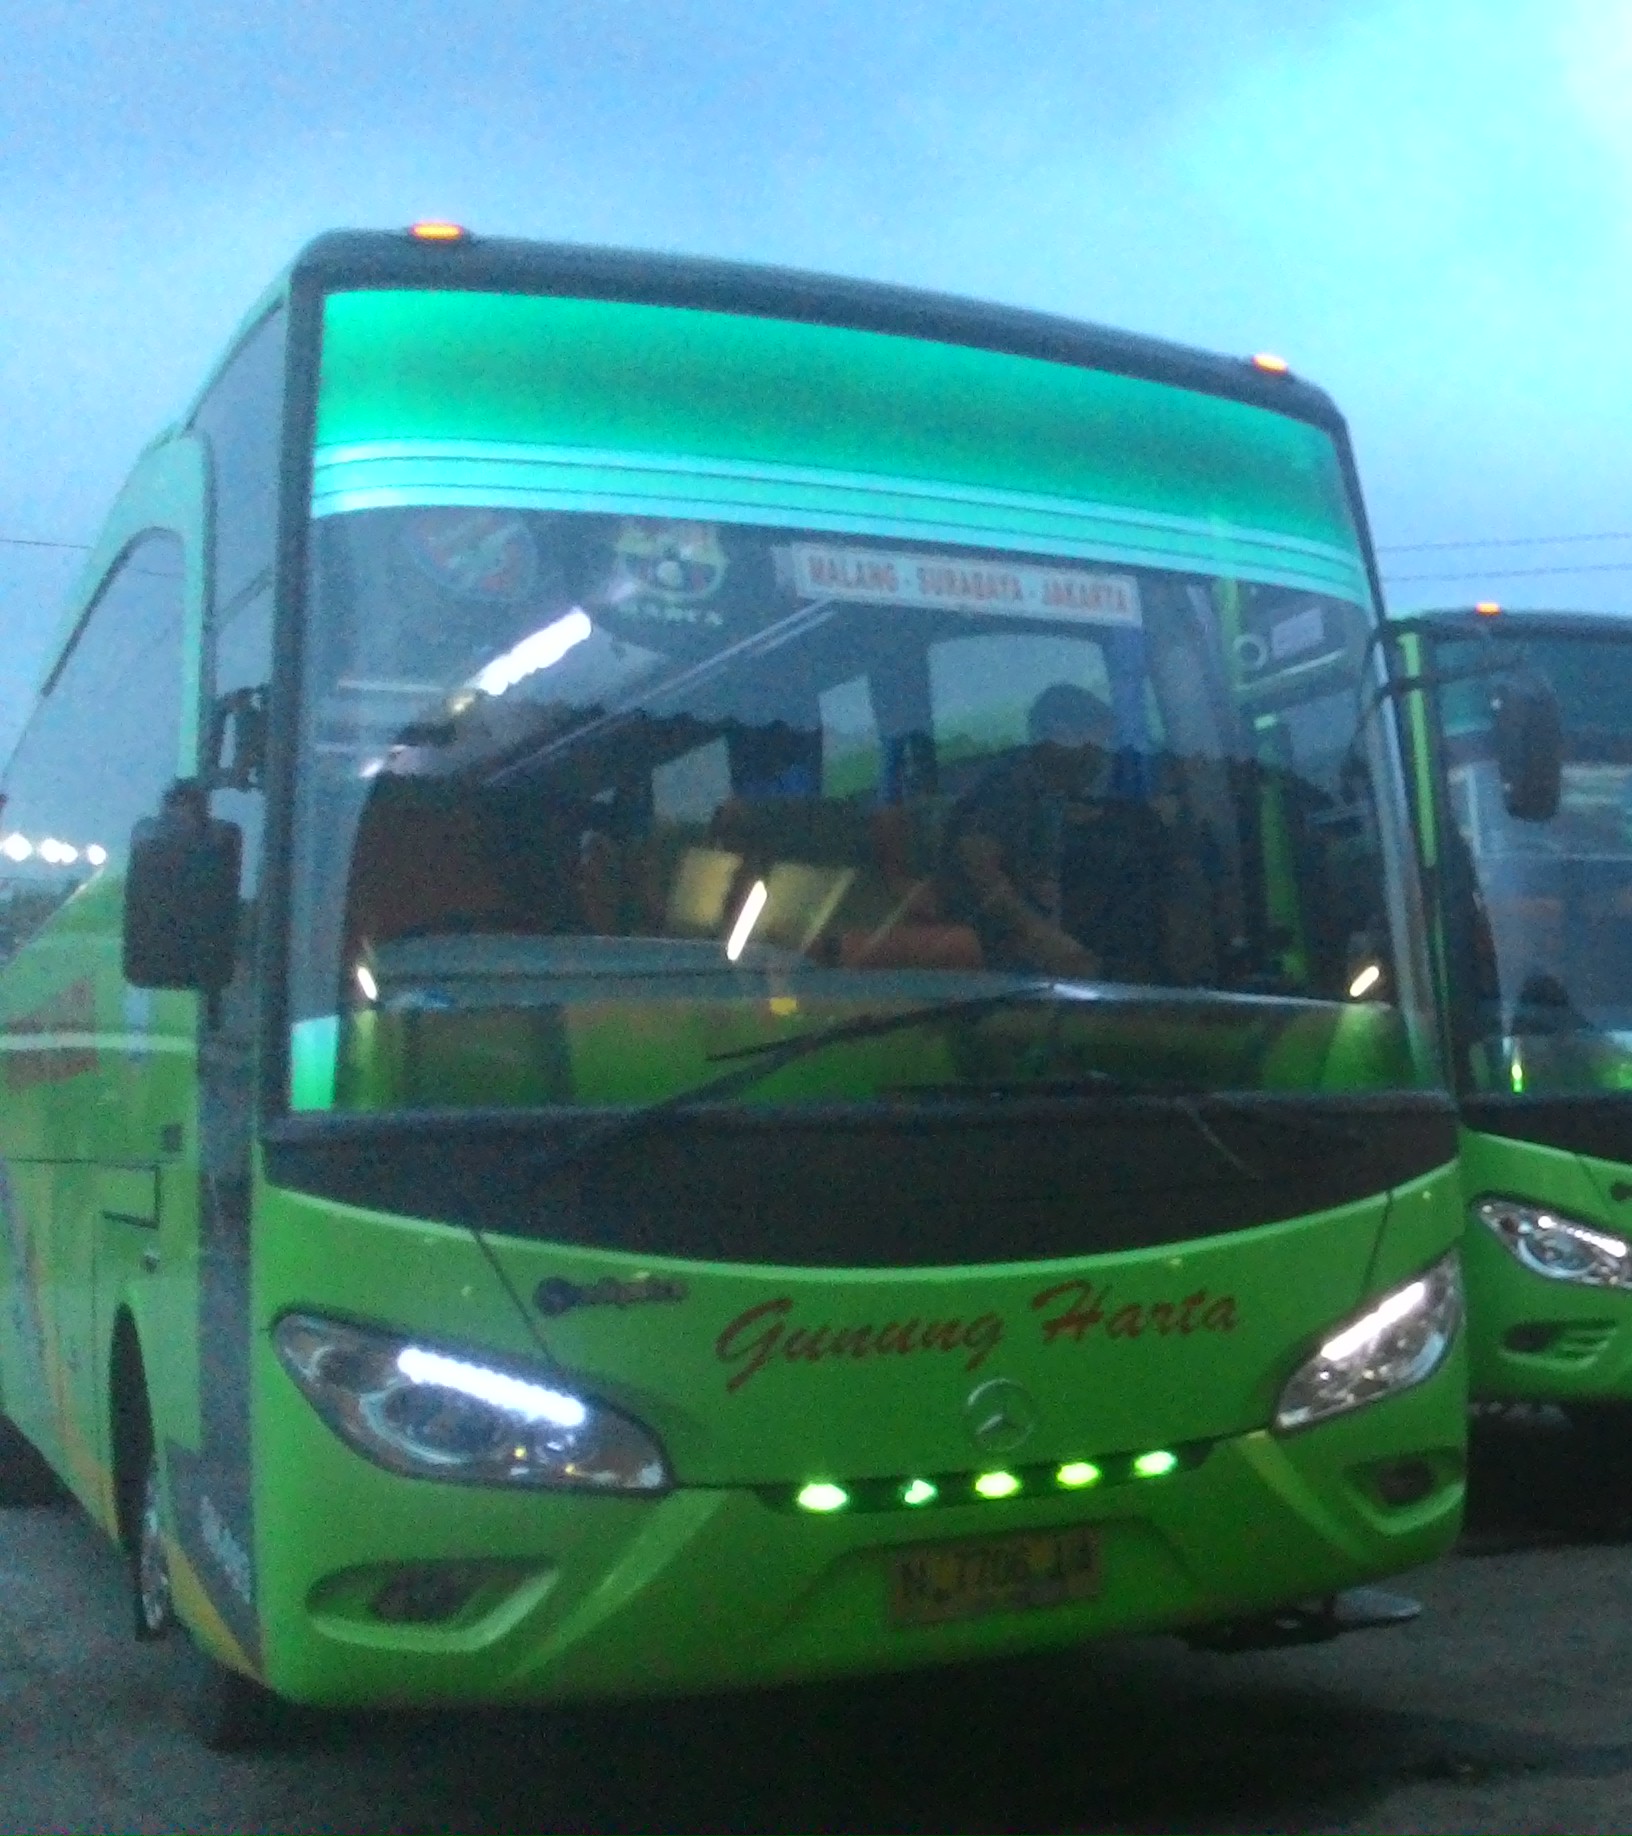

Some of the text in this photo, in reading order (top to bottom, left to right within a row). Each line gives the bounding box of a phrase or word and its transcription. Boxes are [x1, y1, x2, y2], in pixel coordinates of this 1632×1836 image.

[807, 554, 1130, 613] MALANG SURABAYA JAKARTA
[714, 1297, 1003, 1394] Gunung
[1030, 1278, 1239, 1344] Harta
